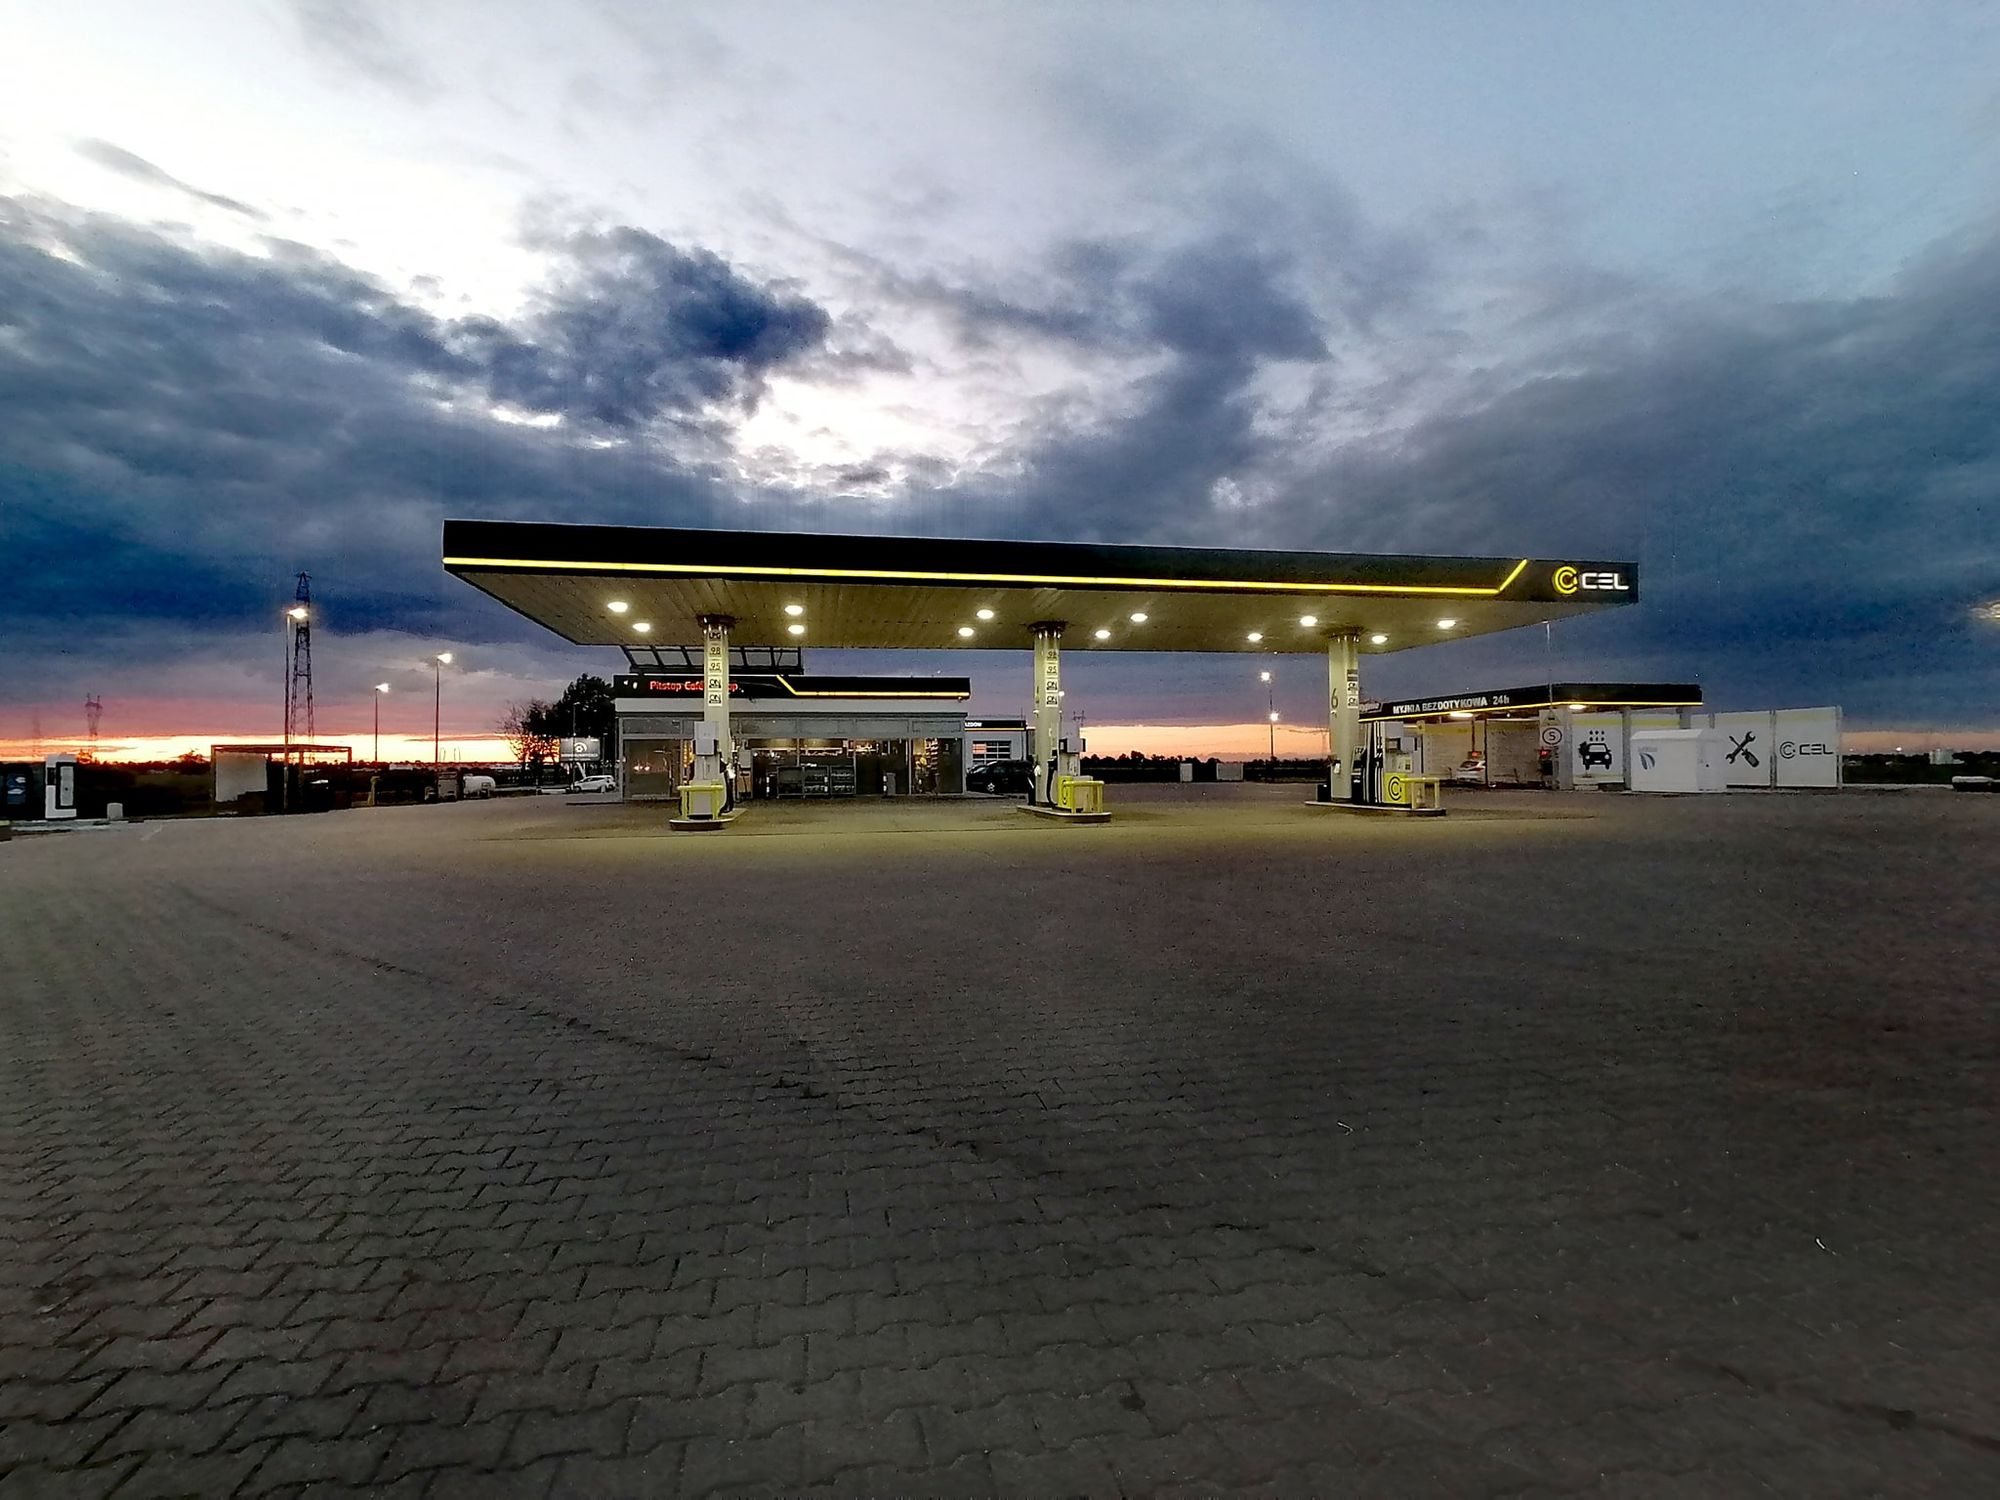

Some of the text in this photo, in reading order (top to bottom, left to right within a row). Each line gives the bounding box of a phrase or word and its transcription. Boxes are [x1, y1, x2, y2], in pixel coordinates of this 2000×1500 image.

[650, 681, 681, 692] Pitstop
[1331, 688, 1338, 709] 6
[1422, 697, 1488, 711] BEZDOTYKOWA
[1493, 695, 1509, 705] 24h
